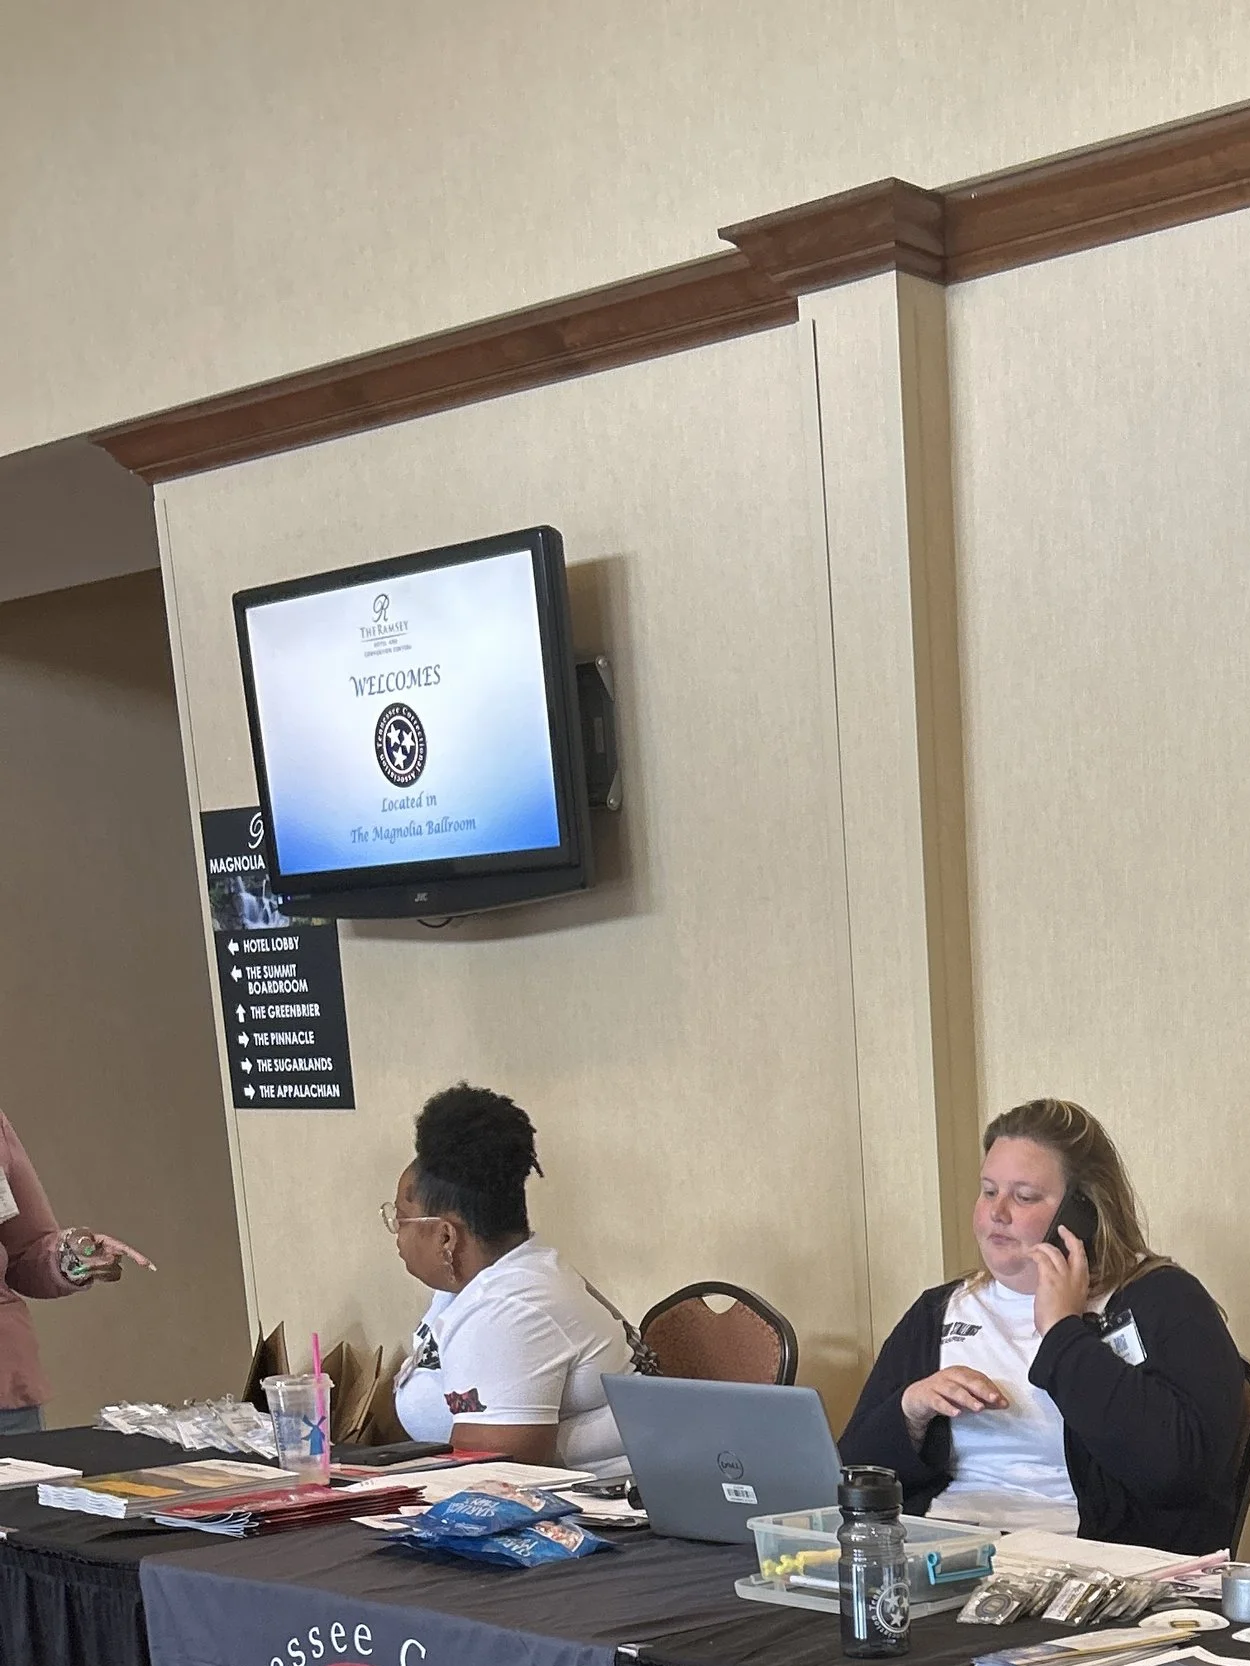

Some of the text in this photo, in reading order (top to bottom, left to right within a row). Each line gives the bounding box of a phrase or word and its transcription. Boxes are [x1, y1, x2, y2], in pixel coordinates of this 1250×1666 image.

[349, 664, 441, 697] WELCOMES
[377, 706, 401, 748] Tennessee
[381, 791, 437, 812] Located in
[350, 816, 477, 844] The Magnolia Ballroom
[209, 854, 266, 874] MAGNOLIA
[243, 936, 299, 953] HOTEL LOBBY
[246, 964, 297, 980] THE SUMMIT
[248, 979, 308, 995] BOARDROOM
[250, 1004, 320, 1019] THE GREENBRIER
[253, 1031, 315, 1046] THE PINNACLE
[256, 1057, 333, 1072] THE SUGARLANDS
[259, 1084, 340, 1098] THE APPALACHIAN
